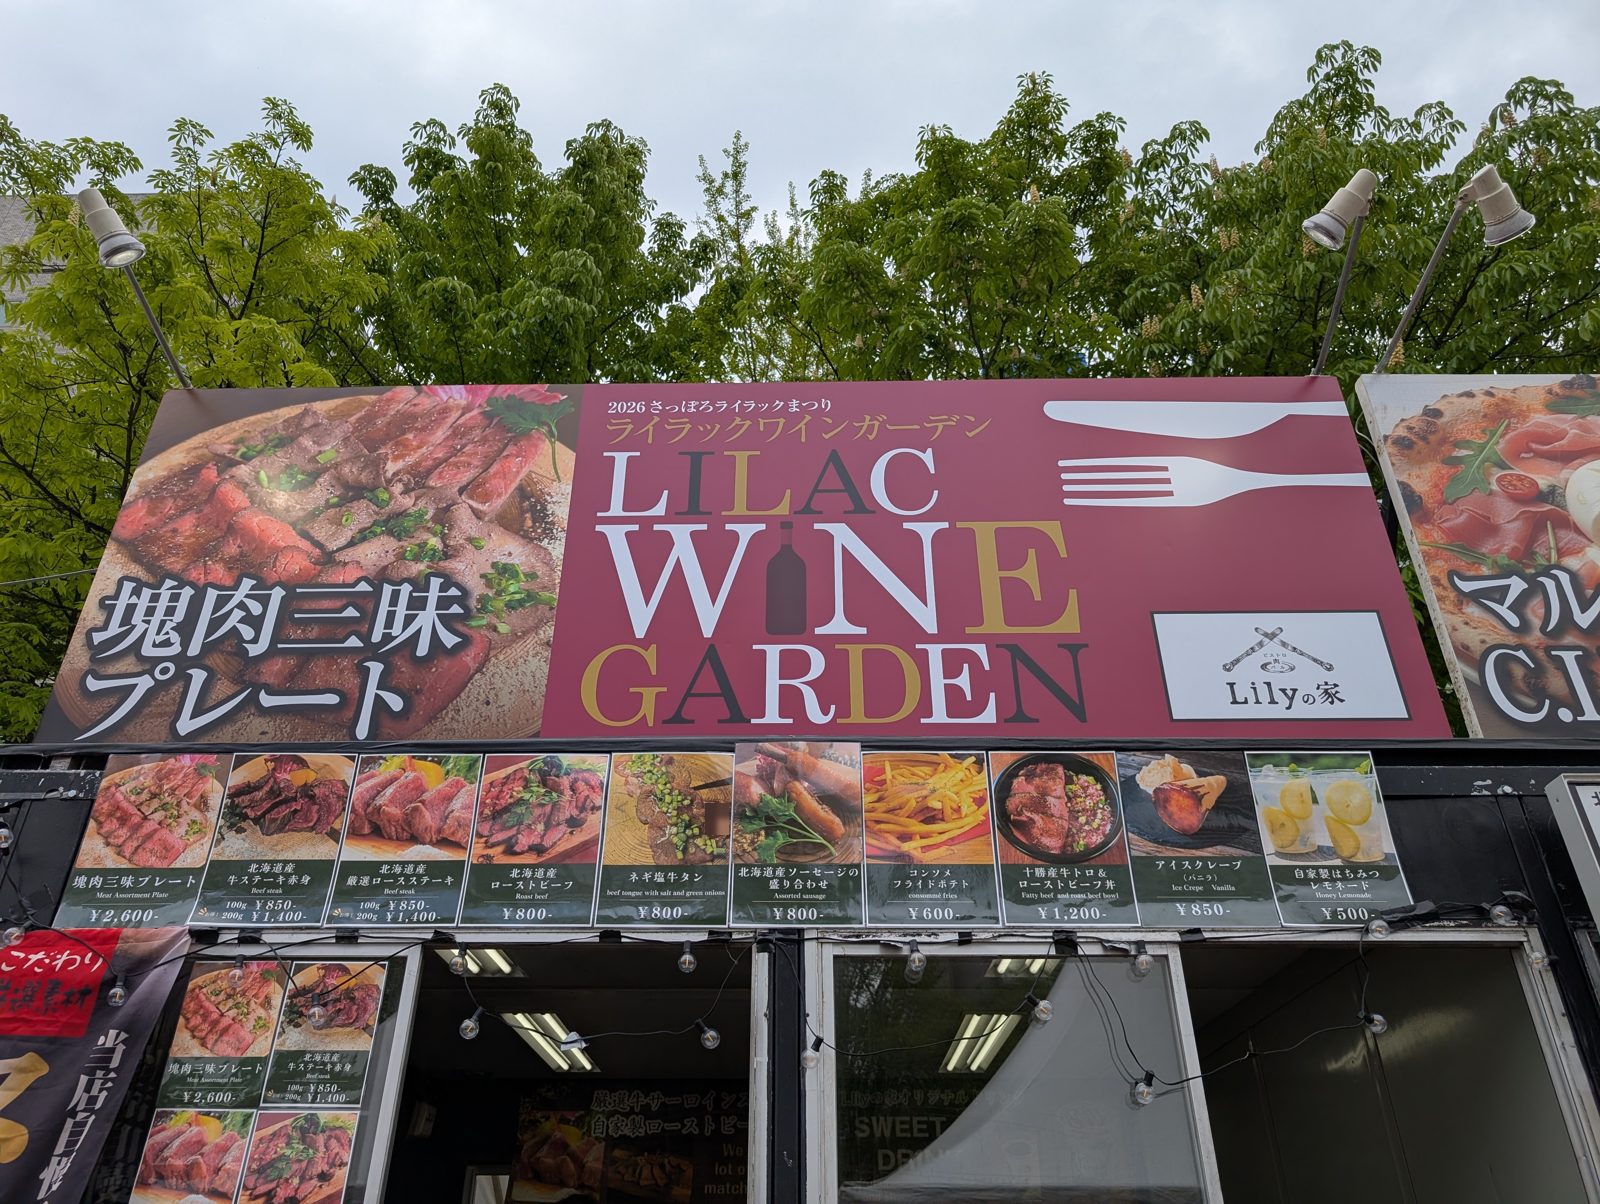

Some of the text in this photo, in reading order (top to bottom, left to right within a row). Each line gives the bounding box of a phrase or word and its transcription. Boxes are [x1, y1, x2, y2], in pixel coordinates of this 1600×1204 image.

[608, 399, 832, 414] 2026 さっぽろライラックまつり
[606, 414, 992, 445] ライラックワインガーデン
[597, 448, 939, 517] LILAC
[91, 577, 464, 659] 塊肉三昧
[580, 643, 1089, 728] GARDEN
[74, 661, 404, 741] プレート
[1226, 681, 1346, 710] Lilyの家
[248, 863, 296, 873] 北海道産
[379, 864, 427, 874] 北海道産
[510, 868, 557, 878] 北海道産
[738, 867, 859, 877] 北海道産ソーセージの
[910, 869, 952, 877] コンソメ
[1294, 868, 1380, 879] 自家製はちみつ
[227, 874, 311, 885] 牛ステーキ赤身
[346, 875, 454, 886] 厳選ロースステーキ
[629, 871, 703, 883] ネギ塩牛タン
[491, 880, 573, 890] ローストビーフ
[769, 878, 829, 889] 盛り合わせ
[893, 880, 969, 889] フライドポテト
[1019, 880, 1116, 890] ローストビーフ丼
[1310, 881, 1369, 890] レモネード
[226, 901, 247, 910] 100g
[360, 902, 381, 910] 100g
[222, 912, 244, 920] 200g
[356, 912, 378, 921] 200g
[1, 950, 104, 973] こだわり
[854, 1116, 946, 1138] SWEET
